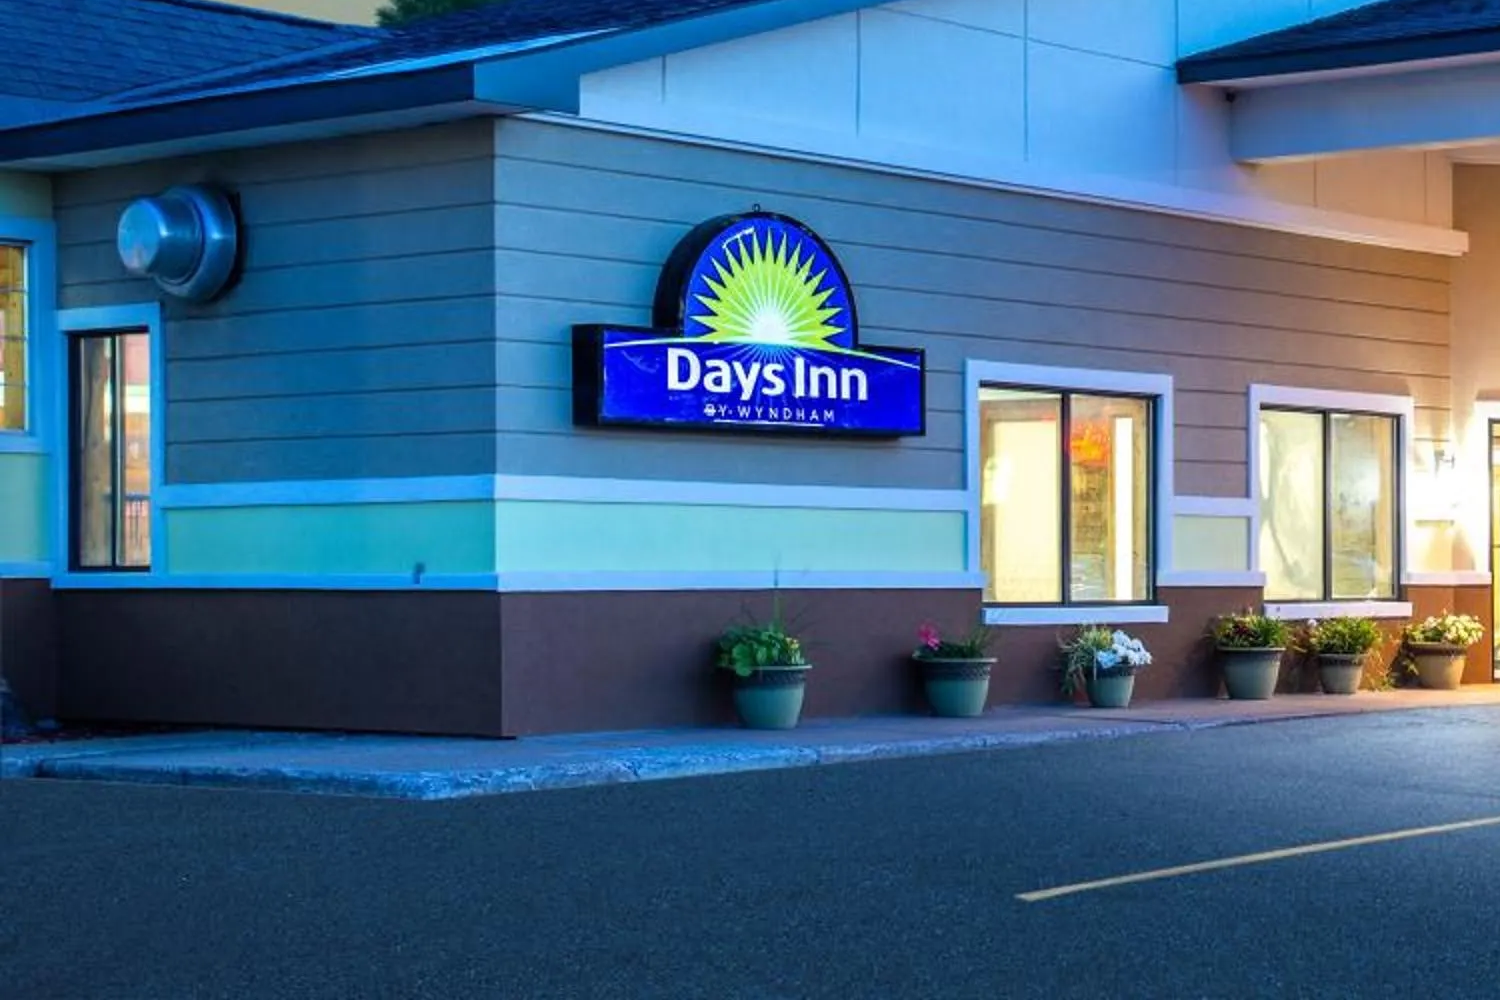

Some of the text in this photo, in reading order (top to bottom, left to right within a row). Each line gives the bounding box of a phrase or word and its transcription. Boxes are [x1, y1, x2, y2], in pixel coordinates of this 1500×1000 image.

[667, 347, 868, 401] Days Inn
[737, 404, 836, 423] WYNDHAM
